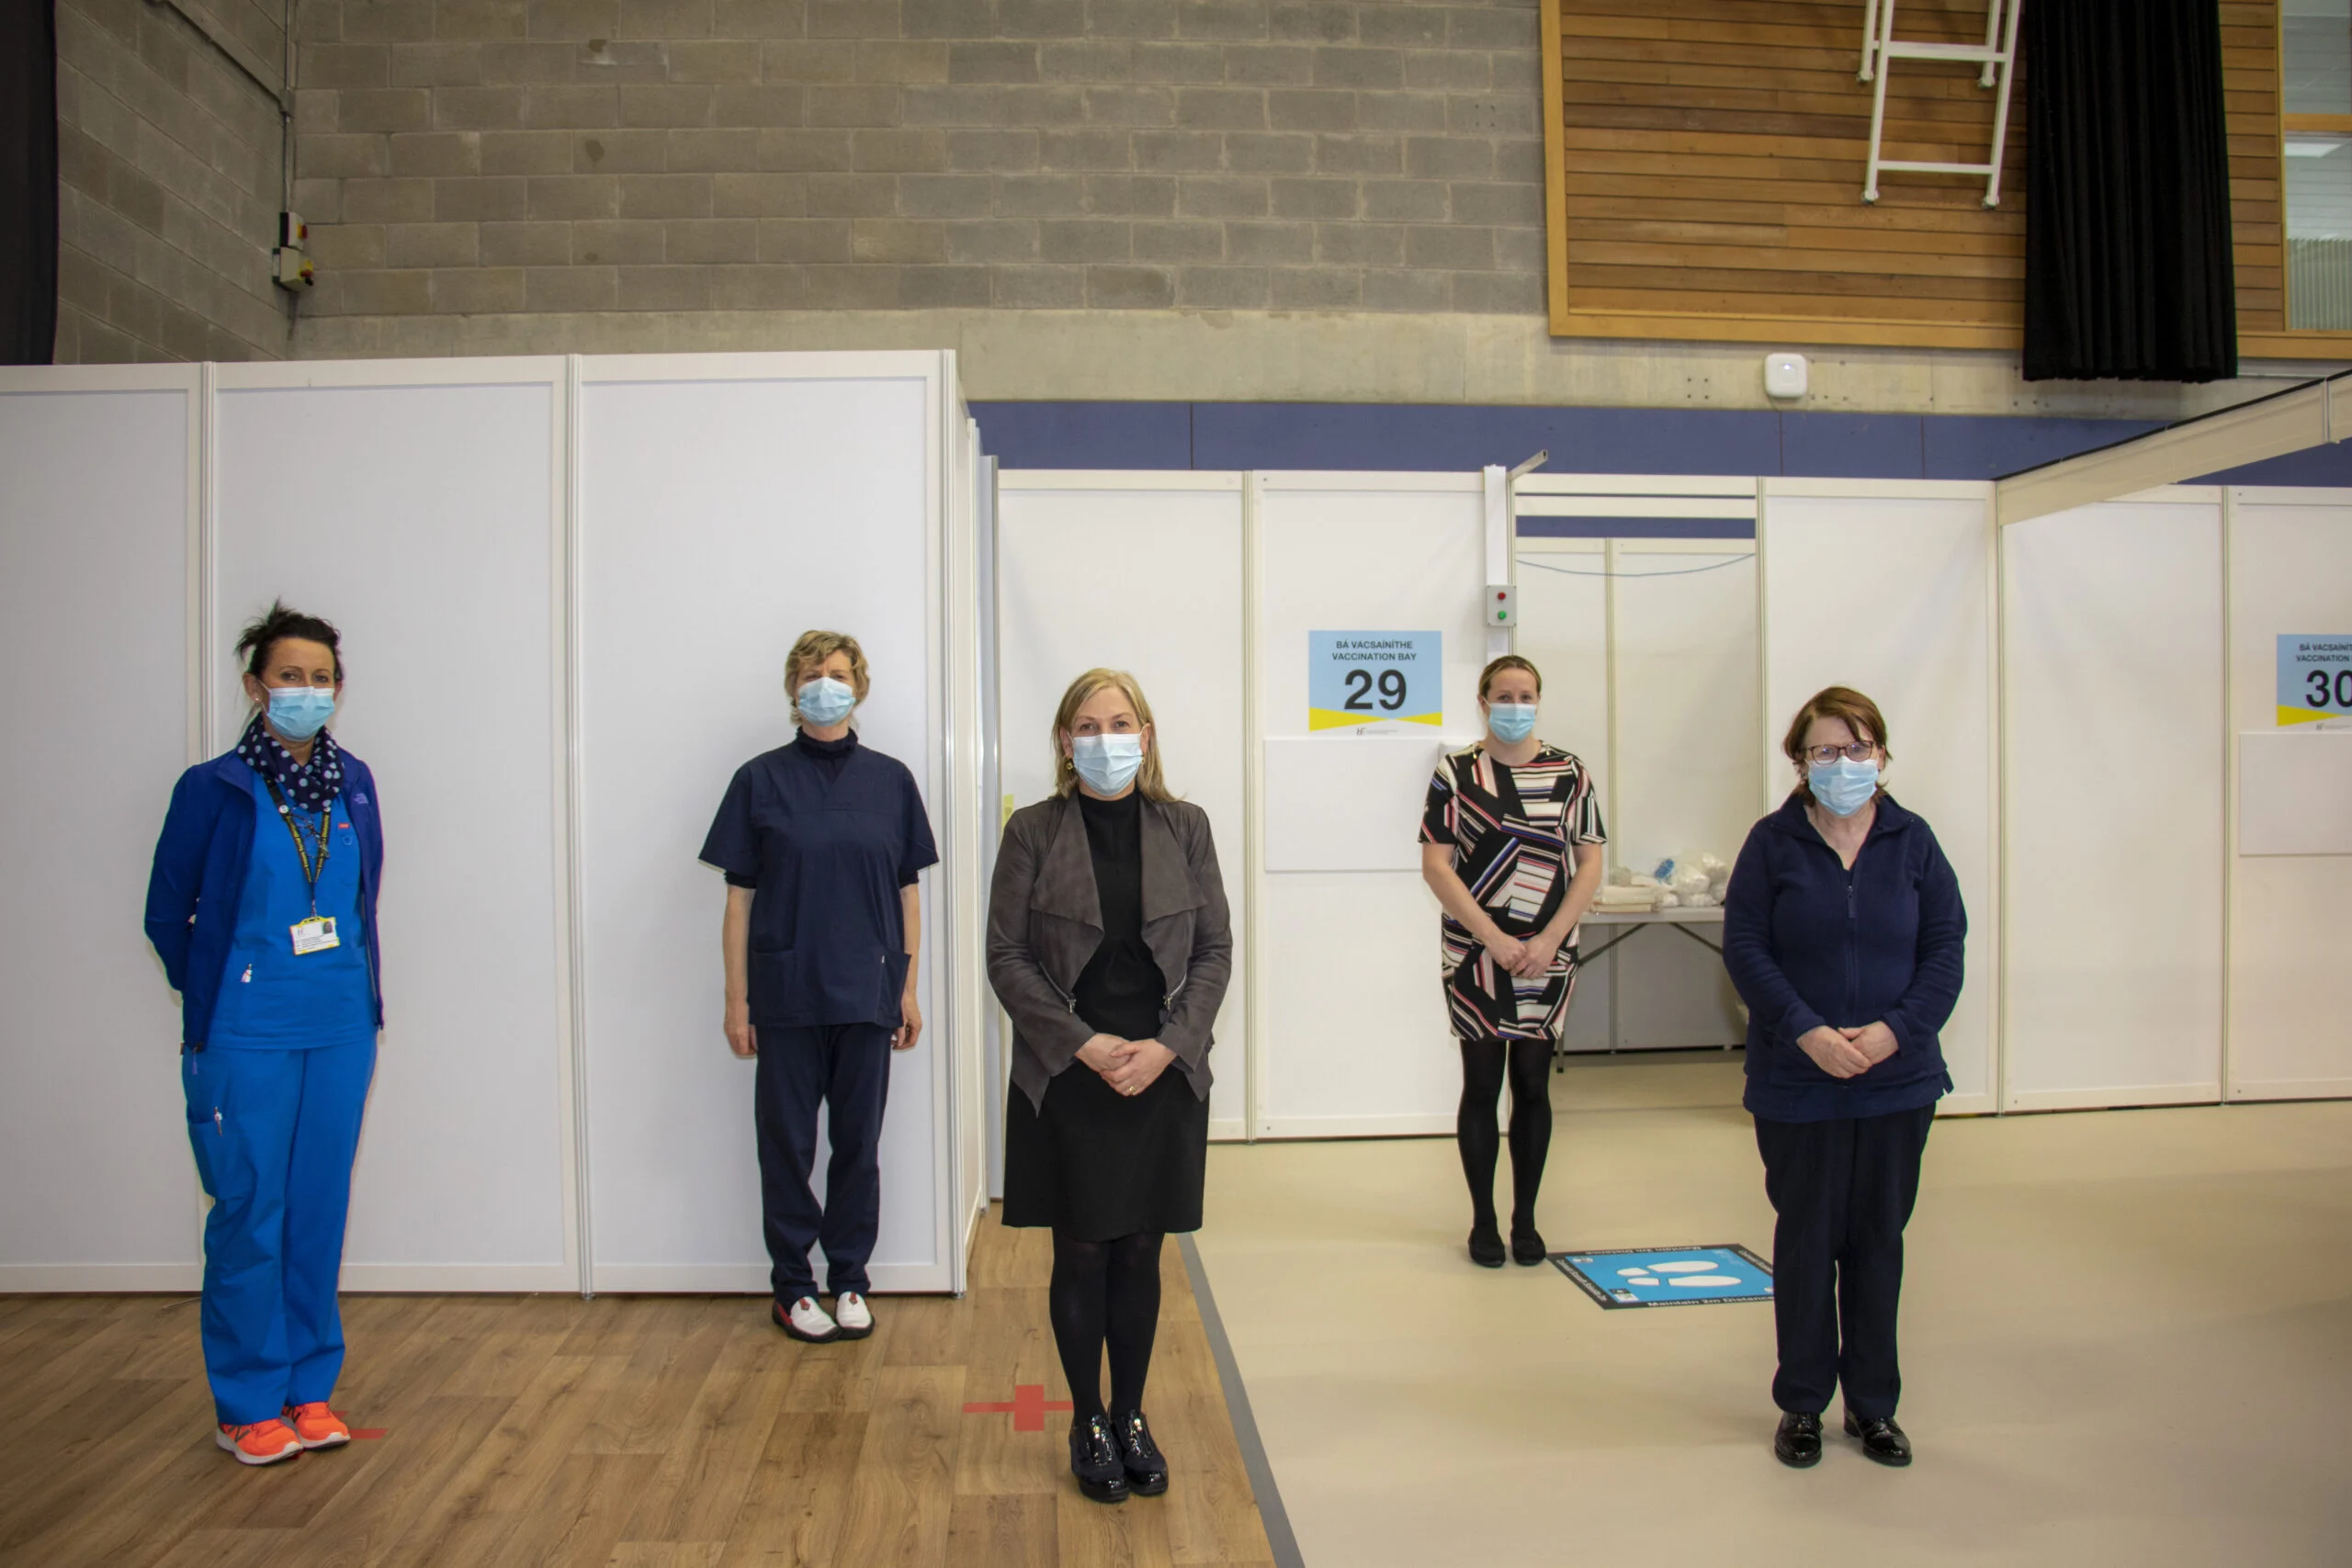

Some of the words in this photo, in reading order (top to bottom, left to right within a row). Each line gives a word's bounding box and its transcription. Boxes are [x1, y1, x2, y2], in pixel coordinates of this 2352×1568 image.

[1336, 639, 1349, 649] BÁ
[2300, 641, 2311, 651] BÁ
[1332, 652, 1396, 661] VACCINATION
[1398, 652, 1417, 661] BAY
[1344, 669, 1407, 710] 29
[2305, 670, 2352, 707] 30
